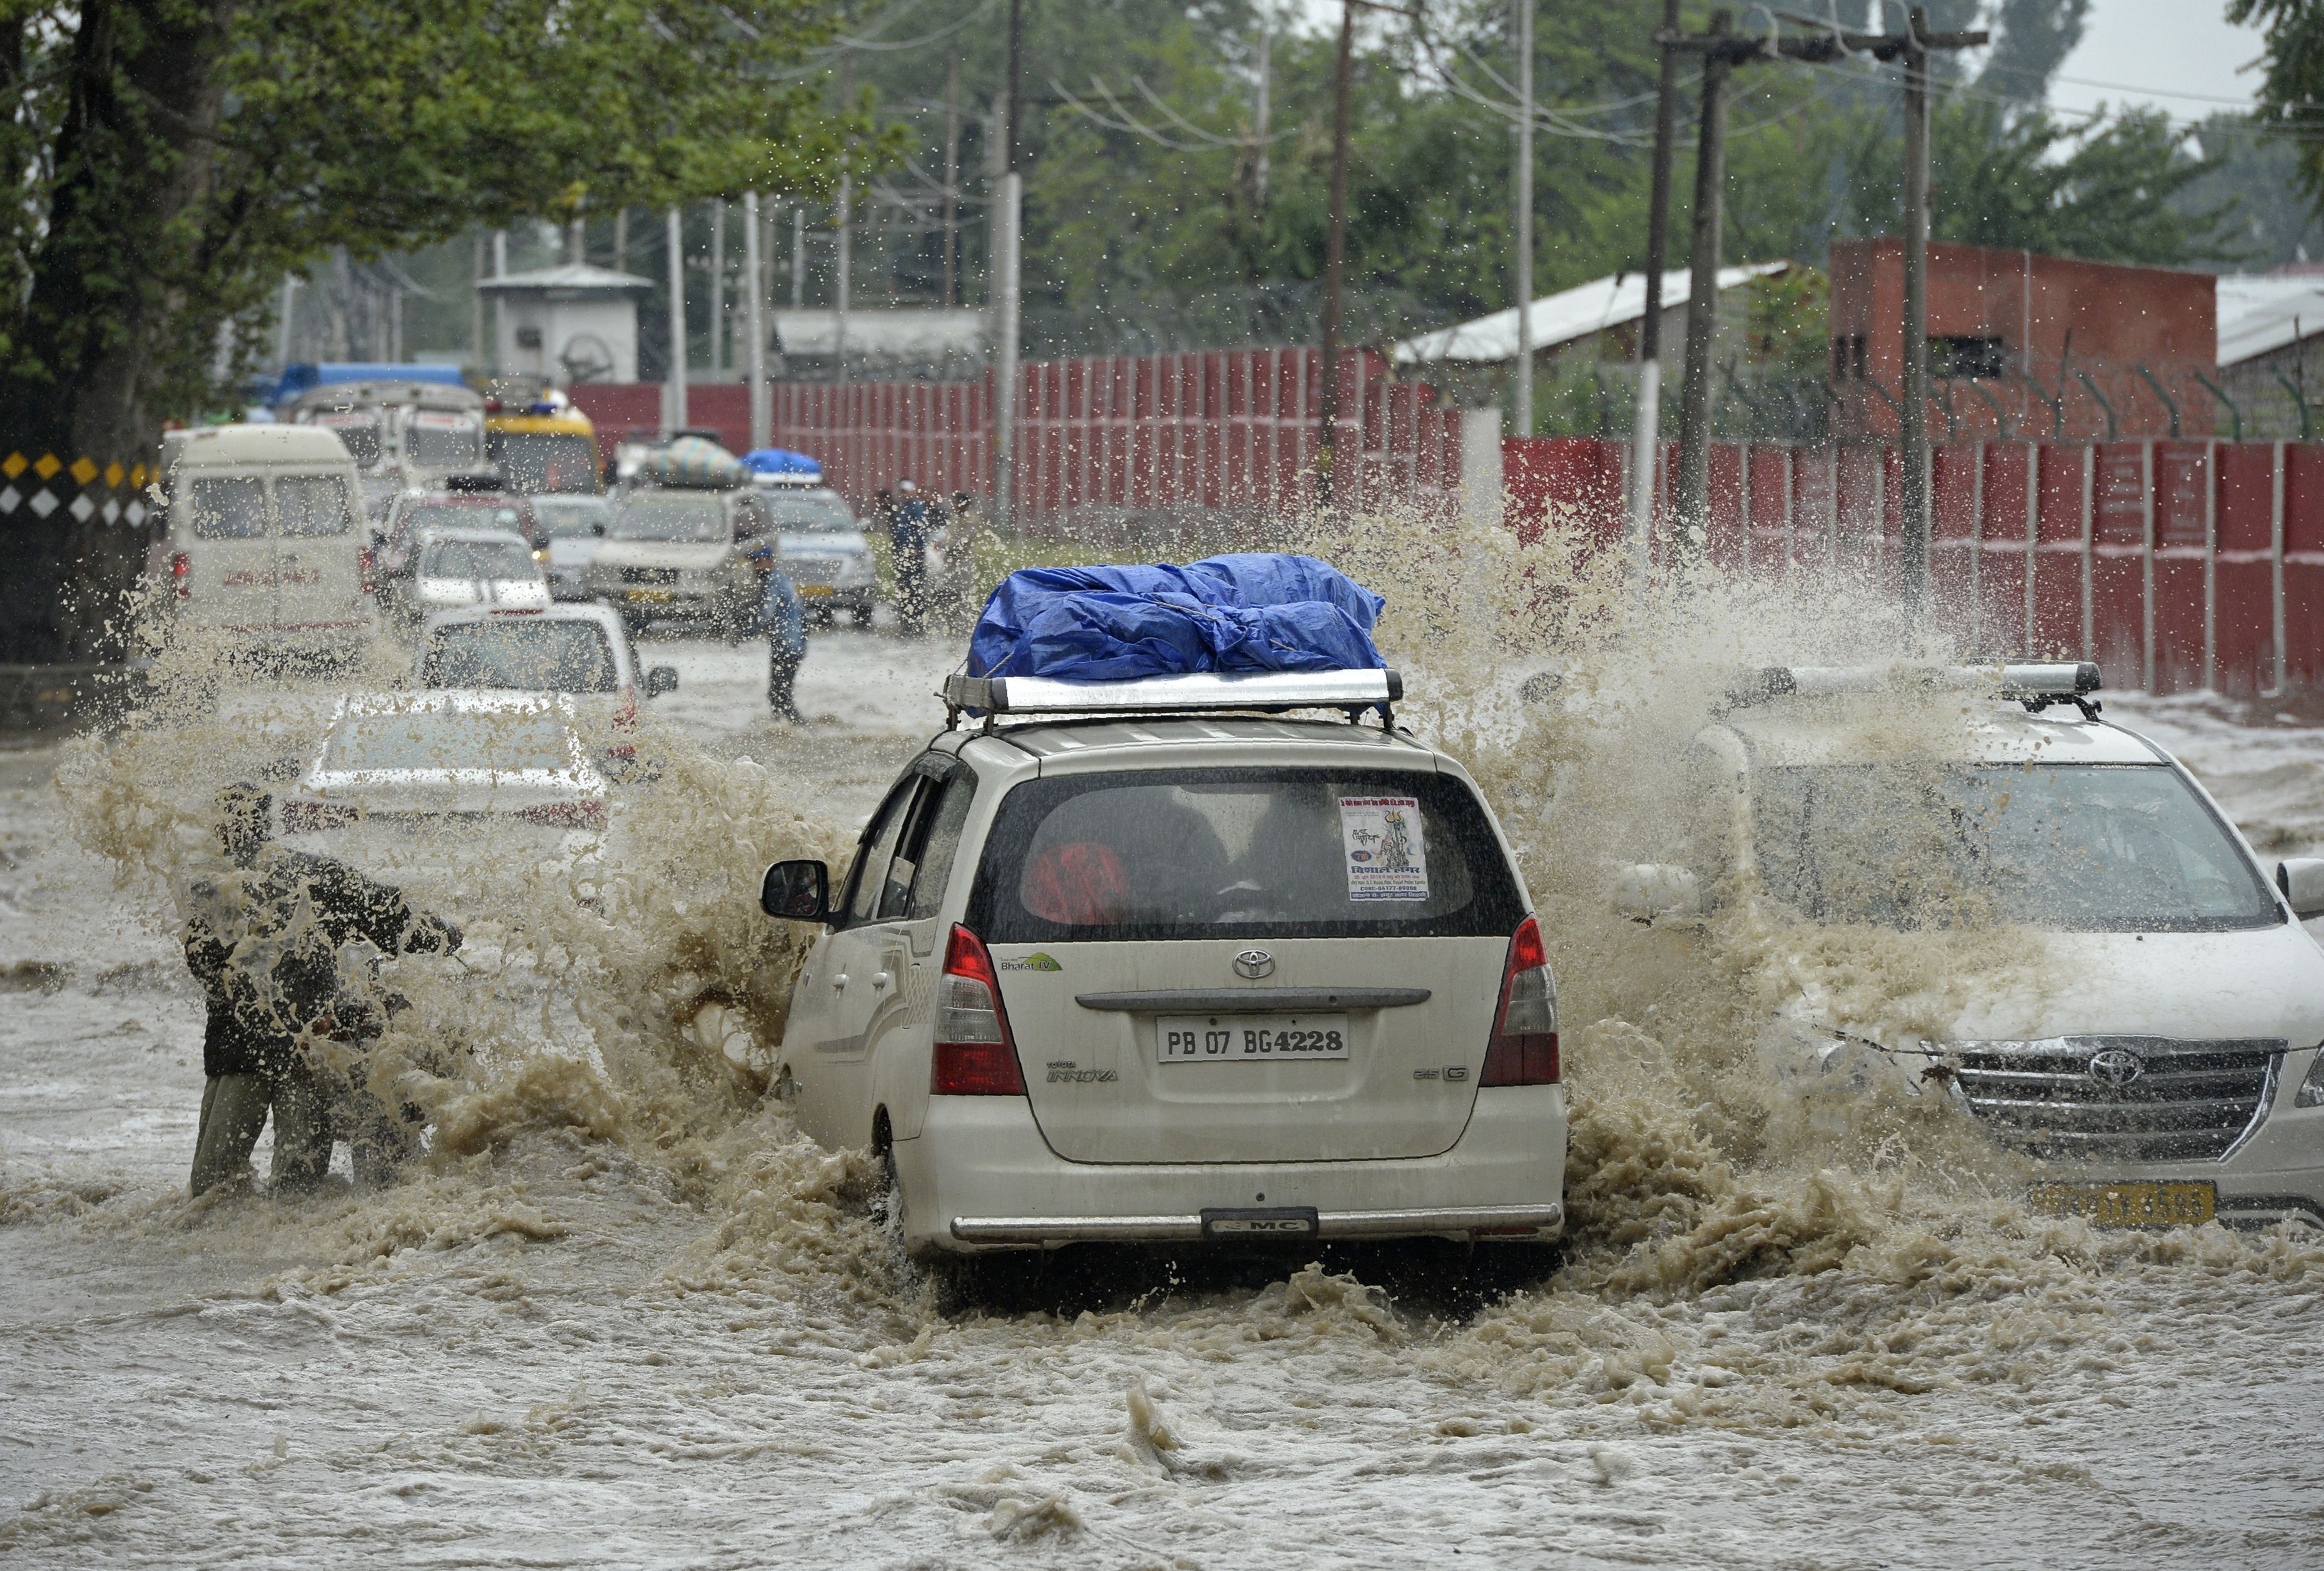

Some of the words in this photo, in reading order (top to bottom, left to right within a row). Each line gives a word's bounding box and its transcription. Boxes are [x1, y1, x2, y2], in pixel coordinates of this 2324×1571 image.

[1039, 961, 1051, 969] IV
[1168, 1032, 1196, 1055] PB
[1205, 1032, 1230, 1054] 07
[1046, 1069, 1117, 1082] INNOVA
